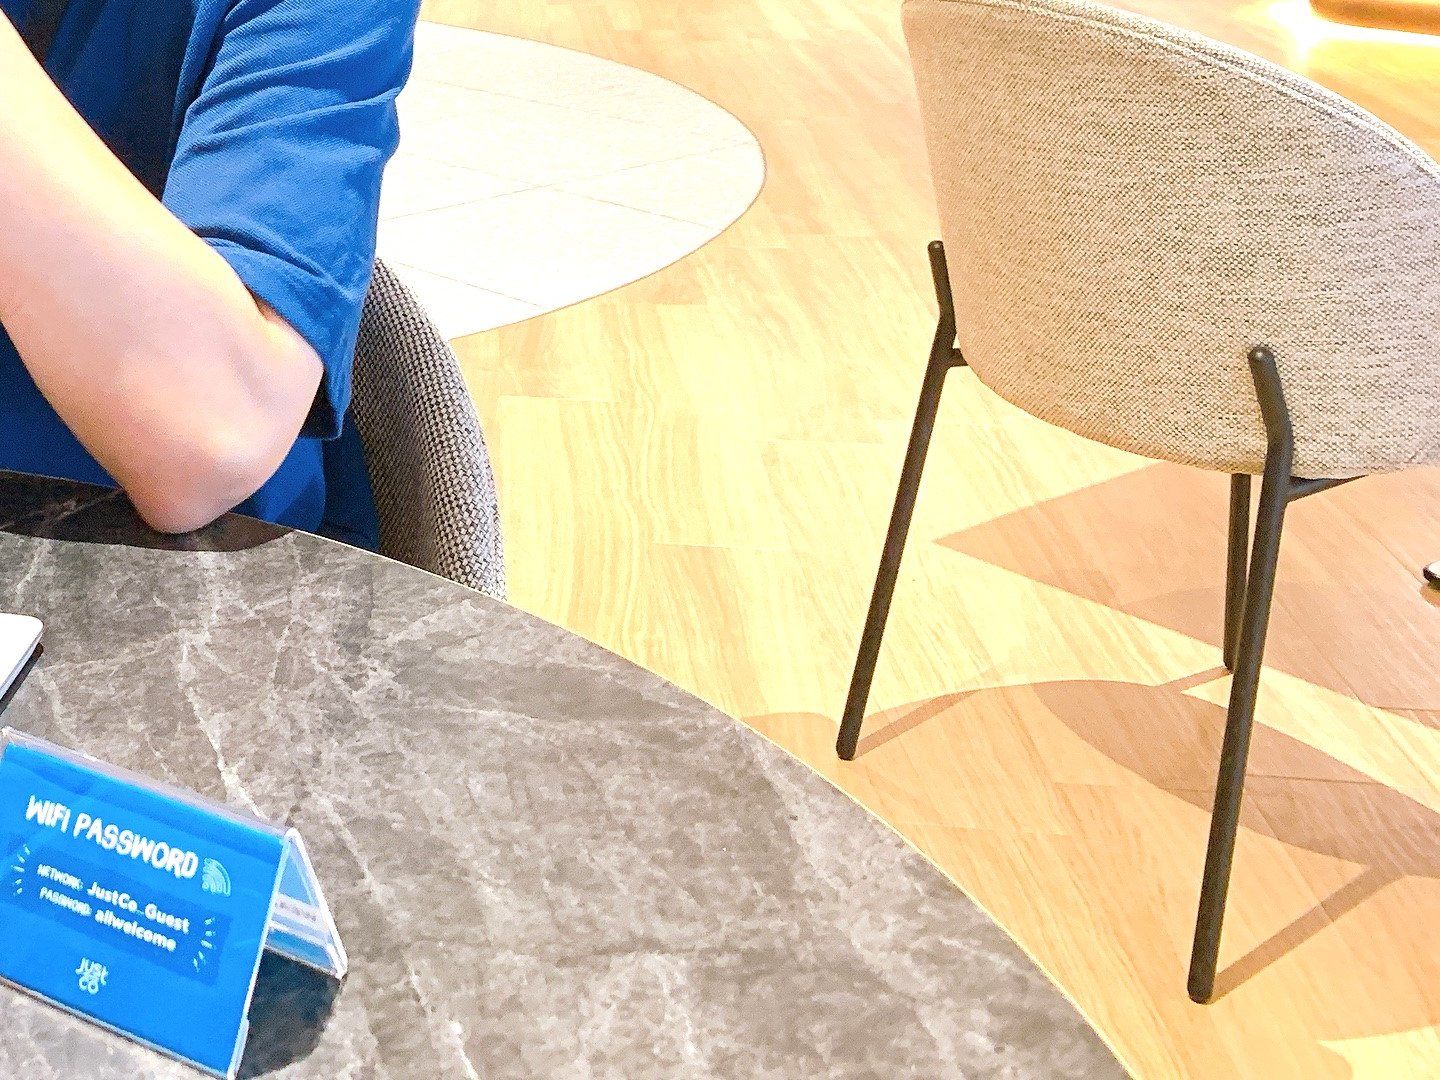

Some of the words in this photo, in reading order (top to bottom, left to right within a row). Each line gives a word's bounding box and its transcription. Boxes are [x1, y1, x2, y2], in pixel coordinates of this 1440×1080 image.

[72, 811, 199, 880] PASSWORD
[86, 881, 191, 935] JustCo_Guest
[94, 909, 178, 953] allwelcome
